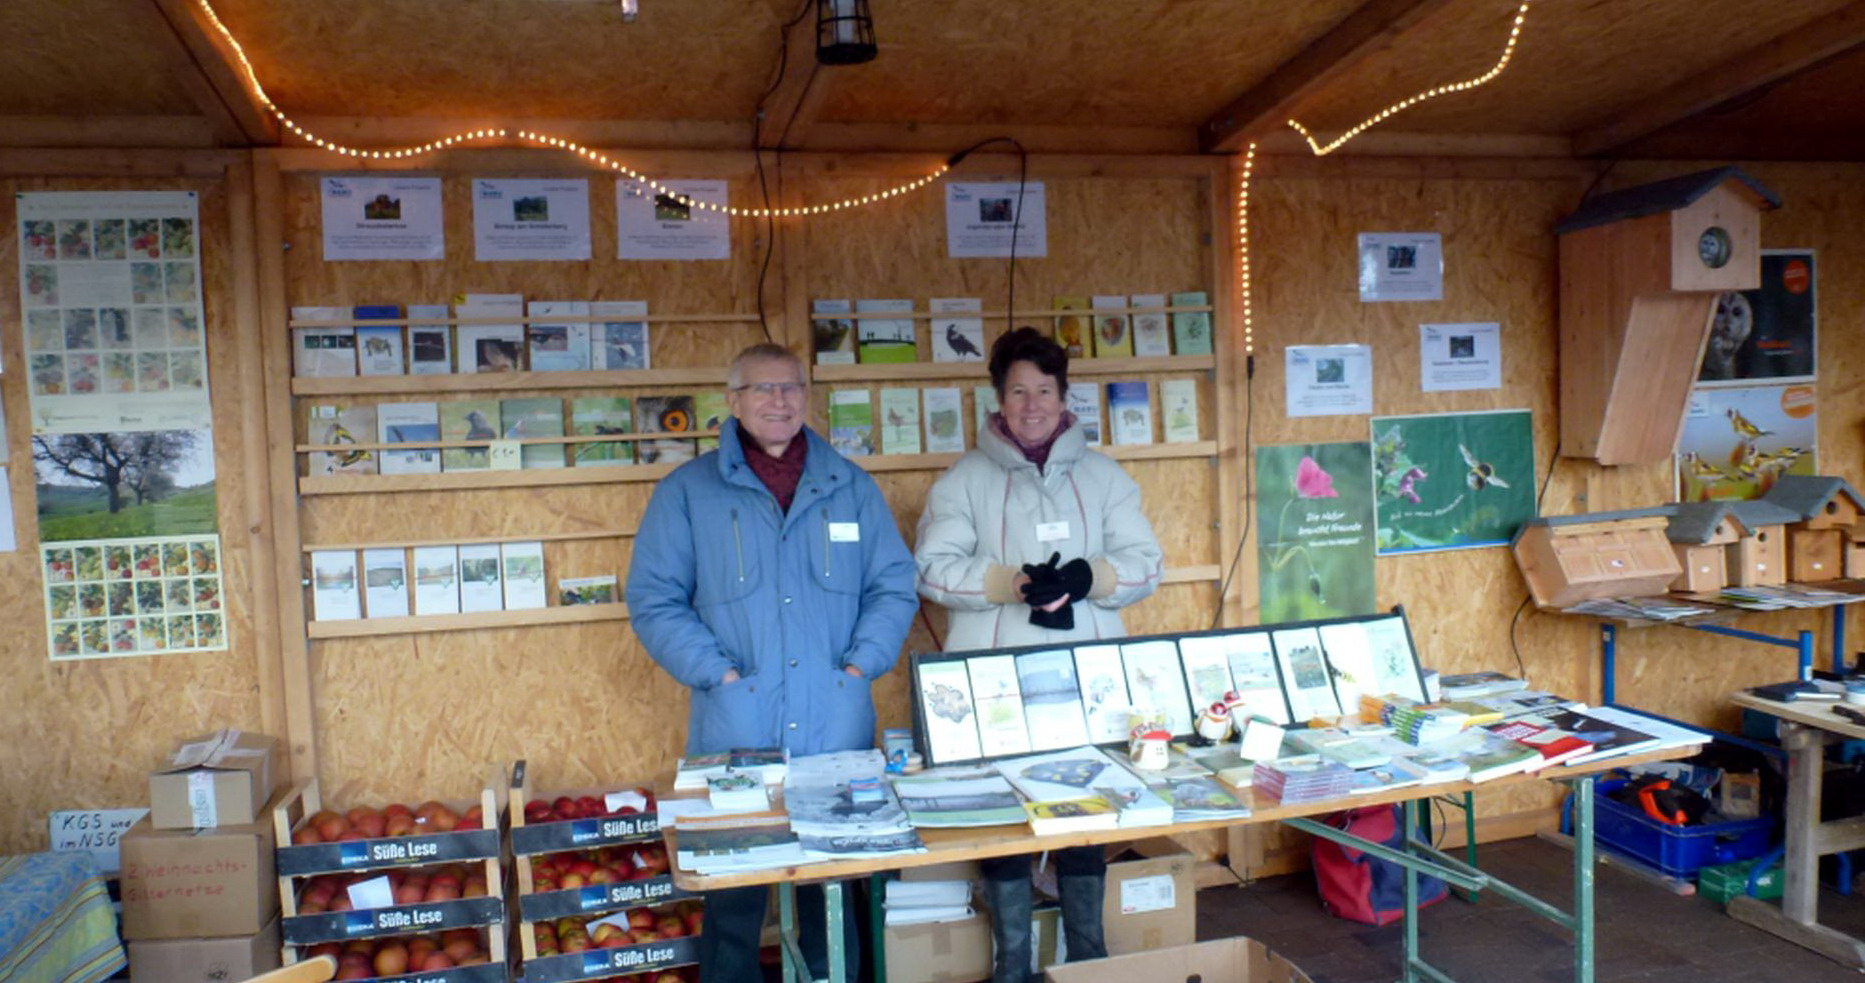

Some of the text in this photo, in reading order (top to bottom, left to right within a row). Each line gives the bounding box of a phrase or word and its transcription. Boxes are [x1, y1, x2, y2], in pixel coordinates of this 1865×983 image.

[62, 814, 102, 830] KGS
[604, 819, 660, 838] Süße Les
[60, 833, 117, 849] im NSG
[373, 841, 437, 860] Süße Lese
[612, 882, 672, 902] Süße Lese
[379, 910, 442, 928] Süße Lese
[614, 947, 675, 967] Süße Lese
